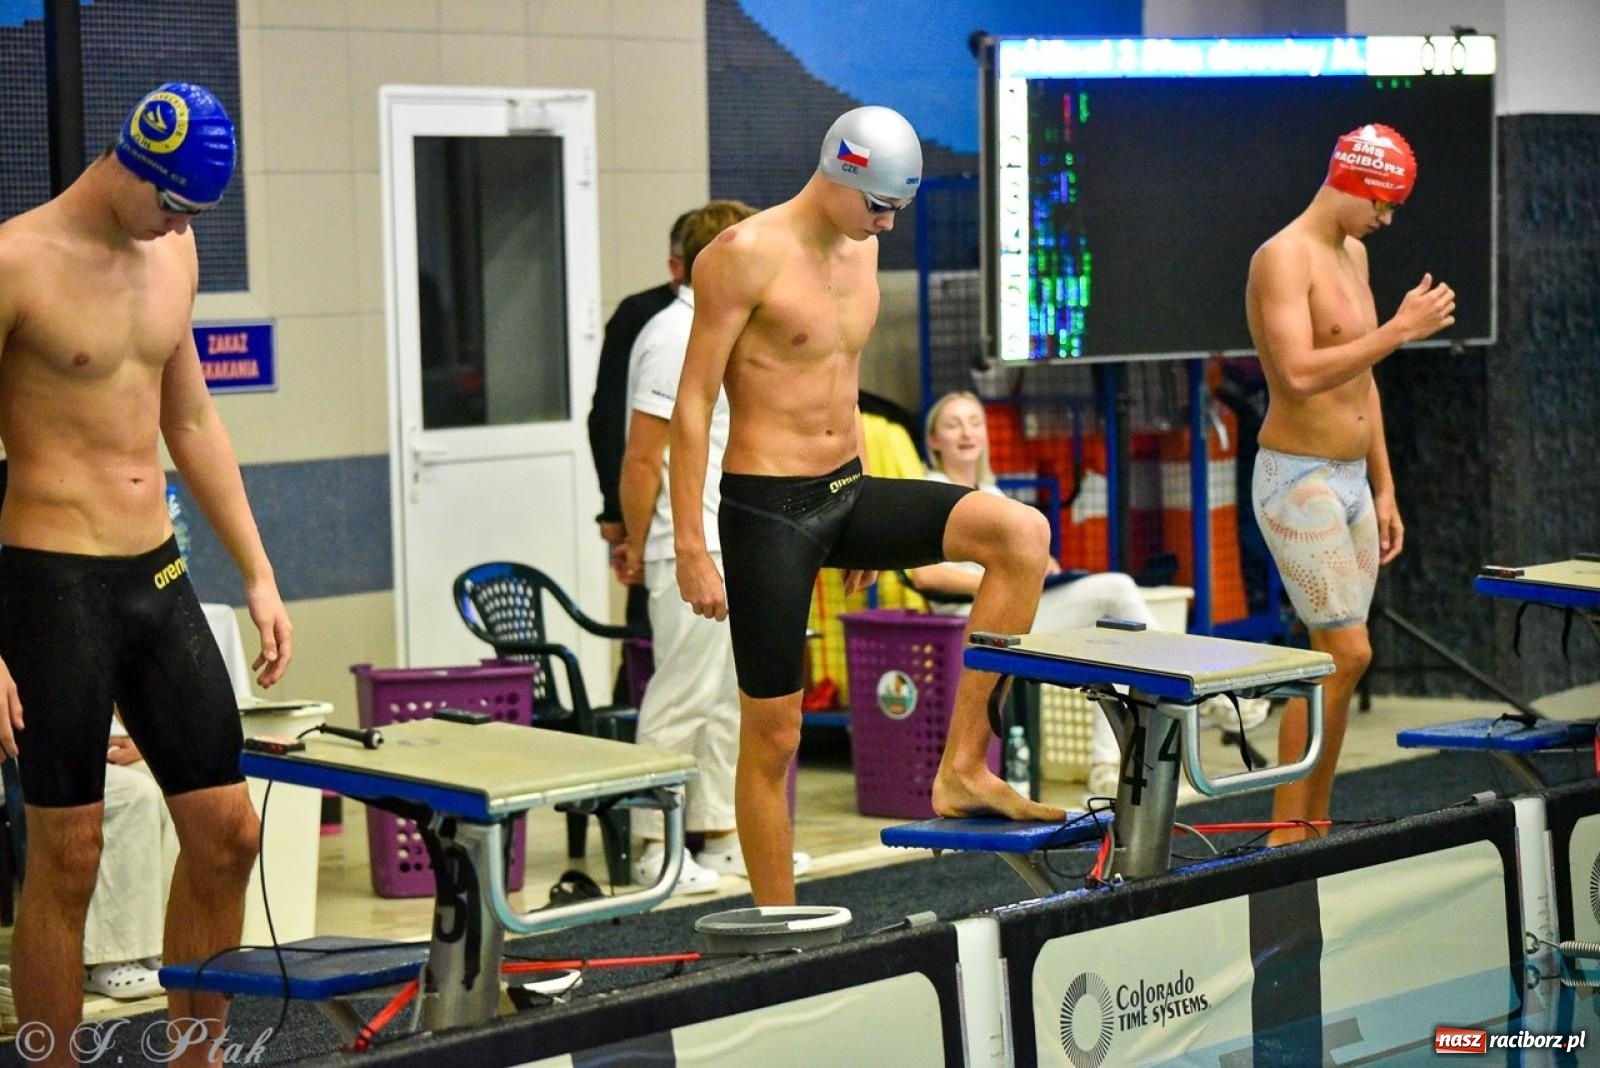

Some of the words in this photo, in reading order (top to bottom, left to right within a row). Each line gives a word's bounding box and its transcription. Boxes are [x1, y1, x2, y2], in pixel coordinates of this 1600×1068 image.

[1352, 142, 1386, 159] SMS
[842, 163, 859, 175] CZE
[208, 332, 249, 355] ZAKAZ
[154, 558, 186, 590] aren
[1118, 1005, 1149, 1032] TIME
